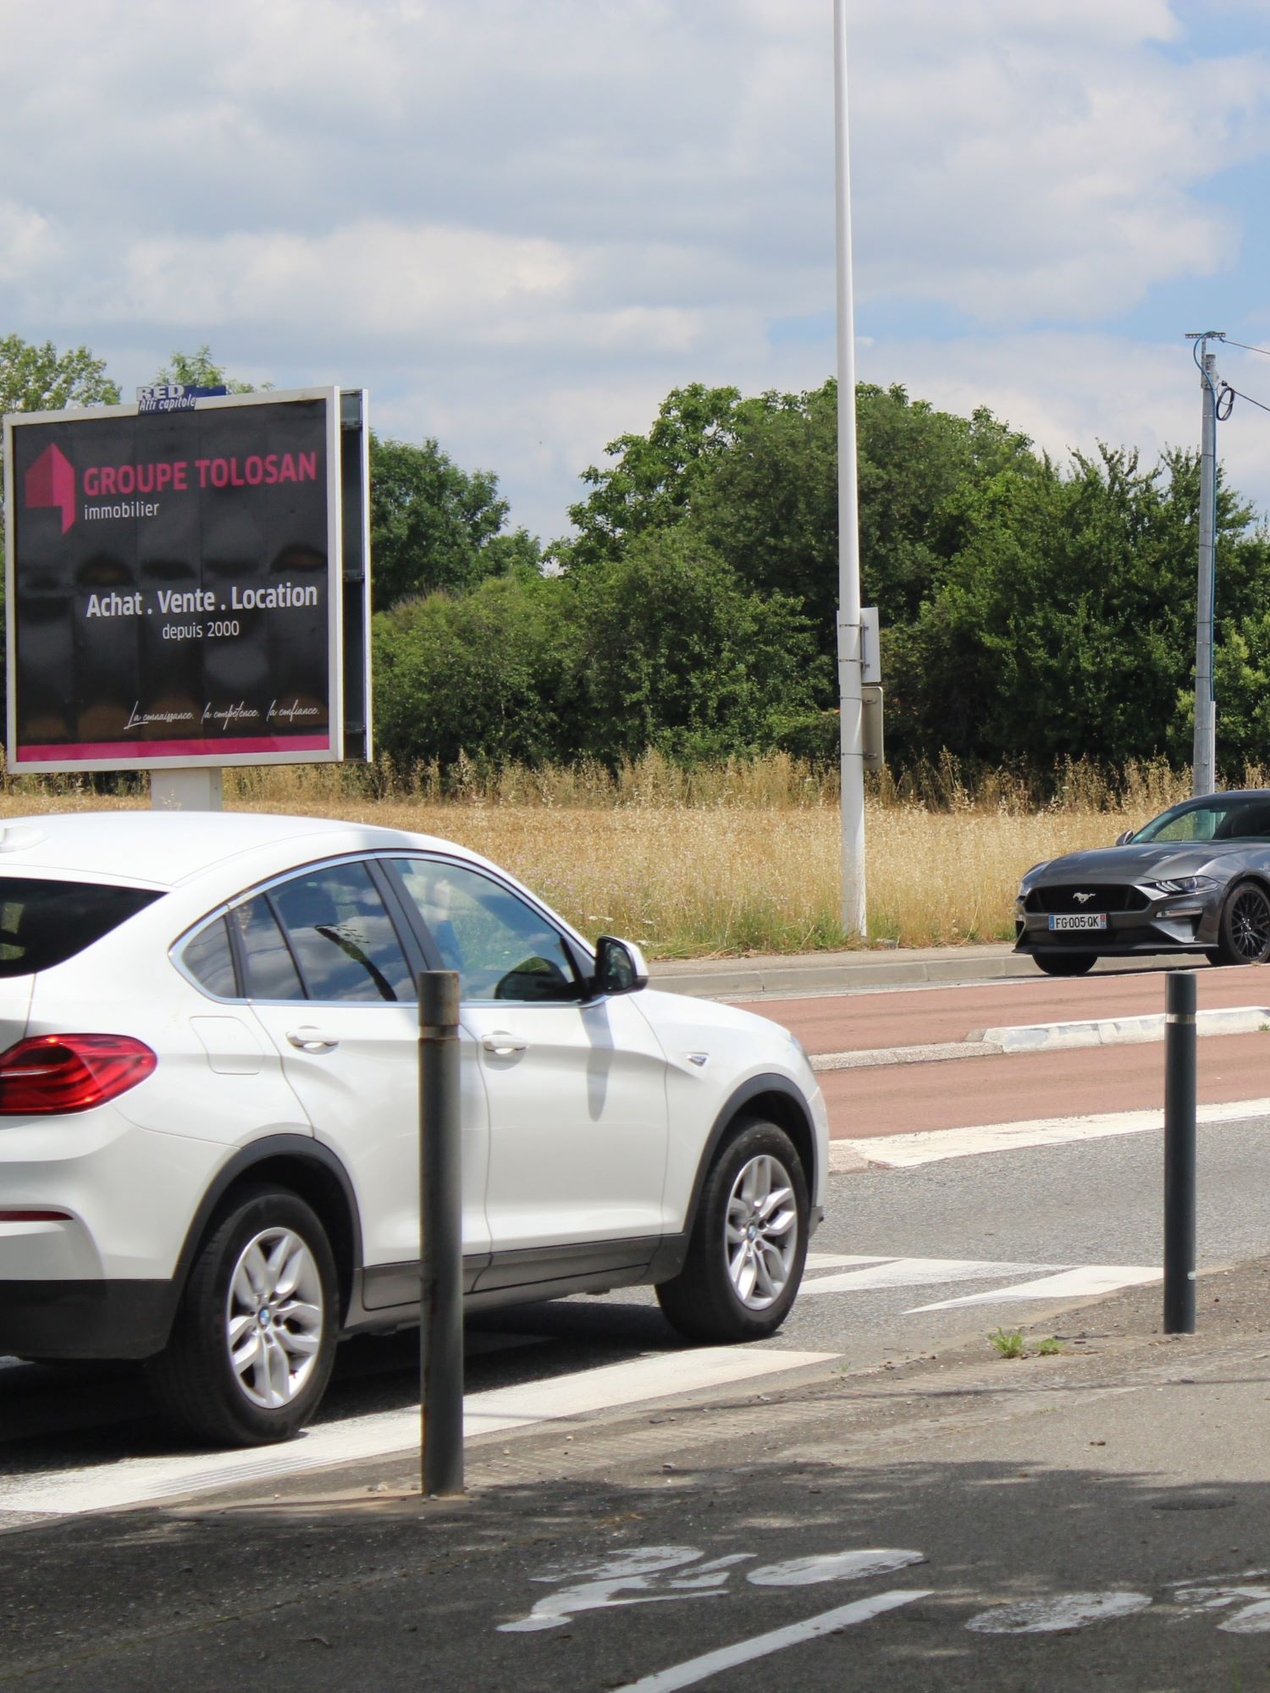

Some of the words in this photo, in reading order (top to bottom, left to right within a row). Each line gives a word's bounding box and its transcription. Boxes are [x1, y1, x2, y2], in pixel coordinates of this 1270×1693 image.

[136, 384, 185, 402] RED
[158, 393, 196, 412] capitole
[83, 461, 188, 496] GROUPE
[195, 451, 318, 488] TOLOSAN
[84, 501, 160, 521] immobilier
[86, 591, 143, 618] Achat
[157, 588, 216, 613] Vente
[231, 582, 318, 610] Location
[162, 622, 203, 642] depuis
[207, 620, 240, 638] 2000
